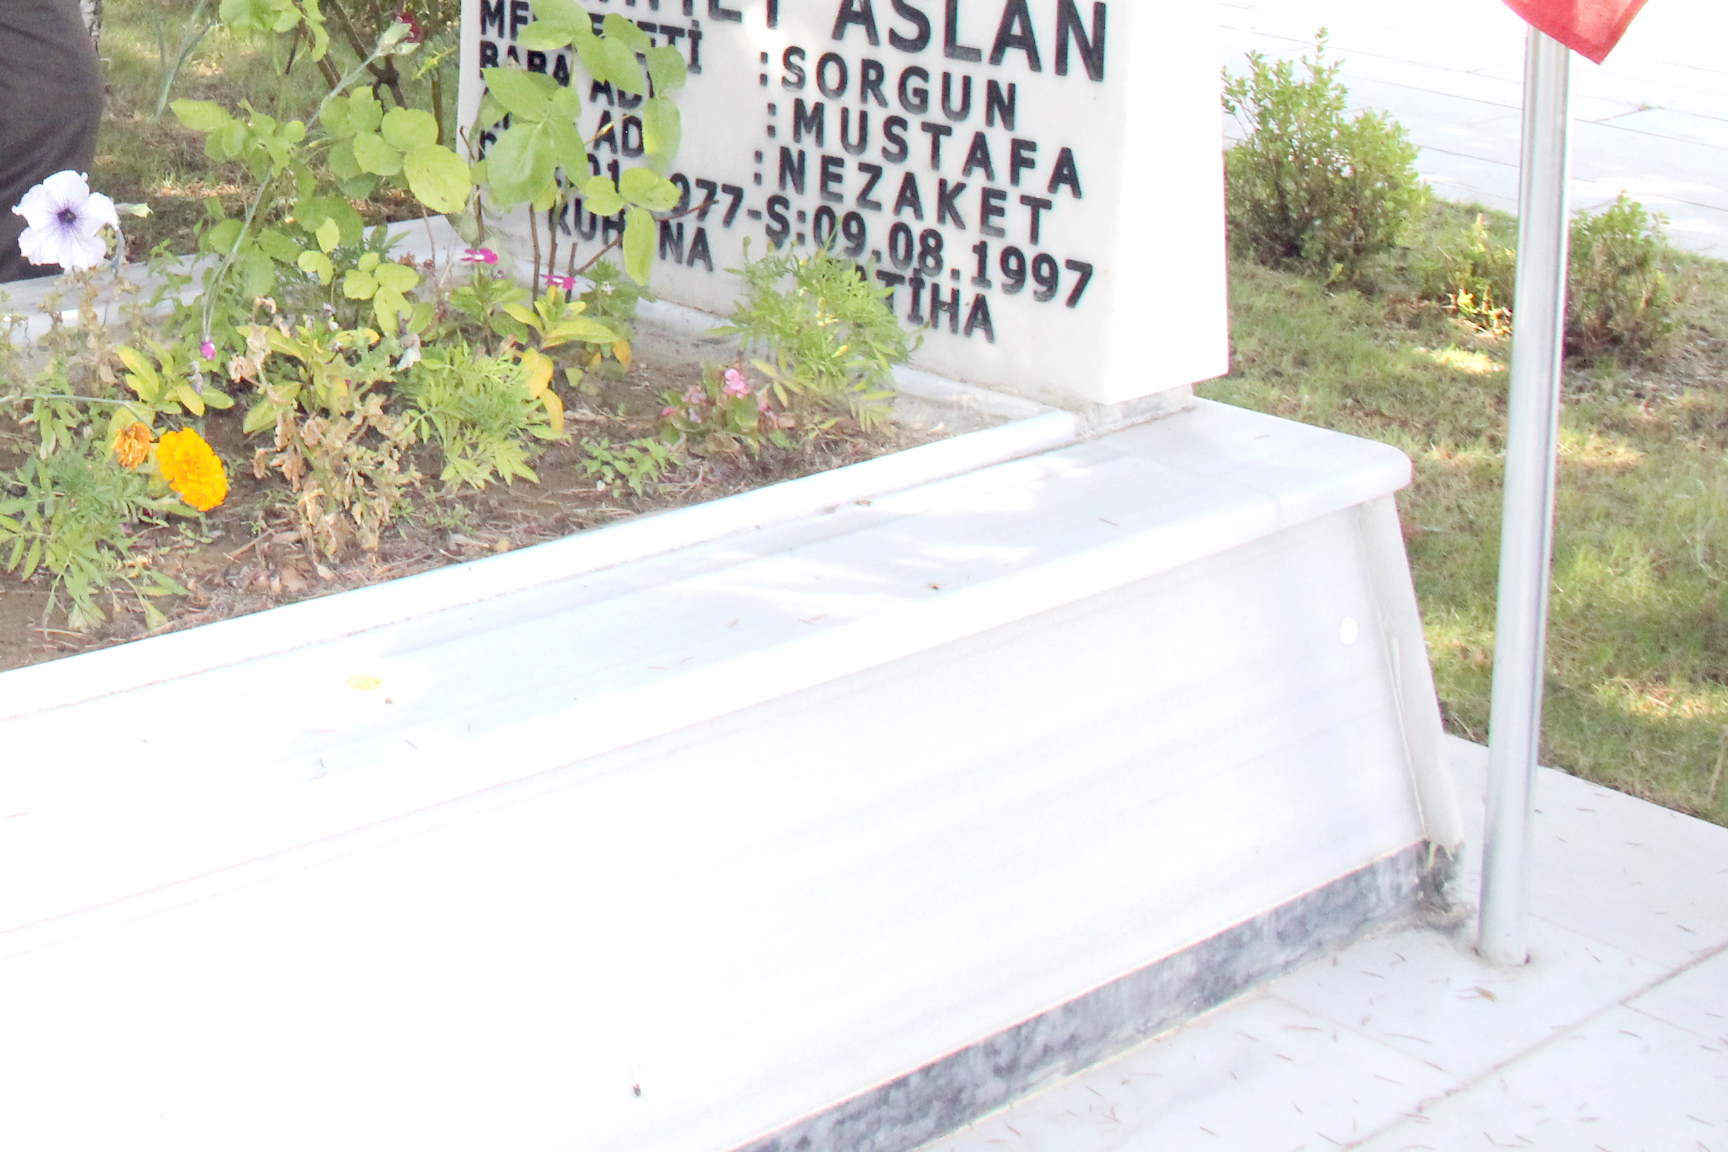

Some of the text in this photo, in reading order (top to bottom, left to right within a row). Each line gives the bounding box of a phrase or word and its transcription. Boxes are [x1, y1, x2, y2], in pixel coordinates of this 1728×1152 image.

[593, 109, 646, 157] AD
[548, 199, 996, 344] RUHNA TİHA
